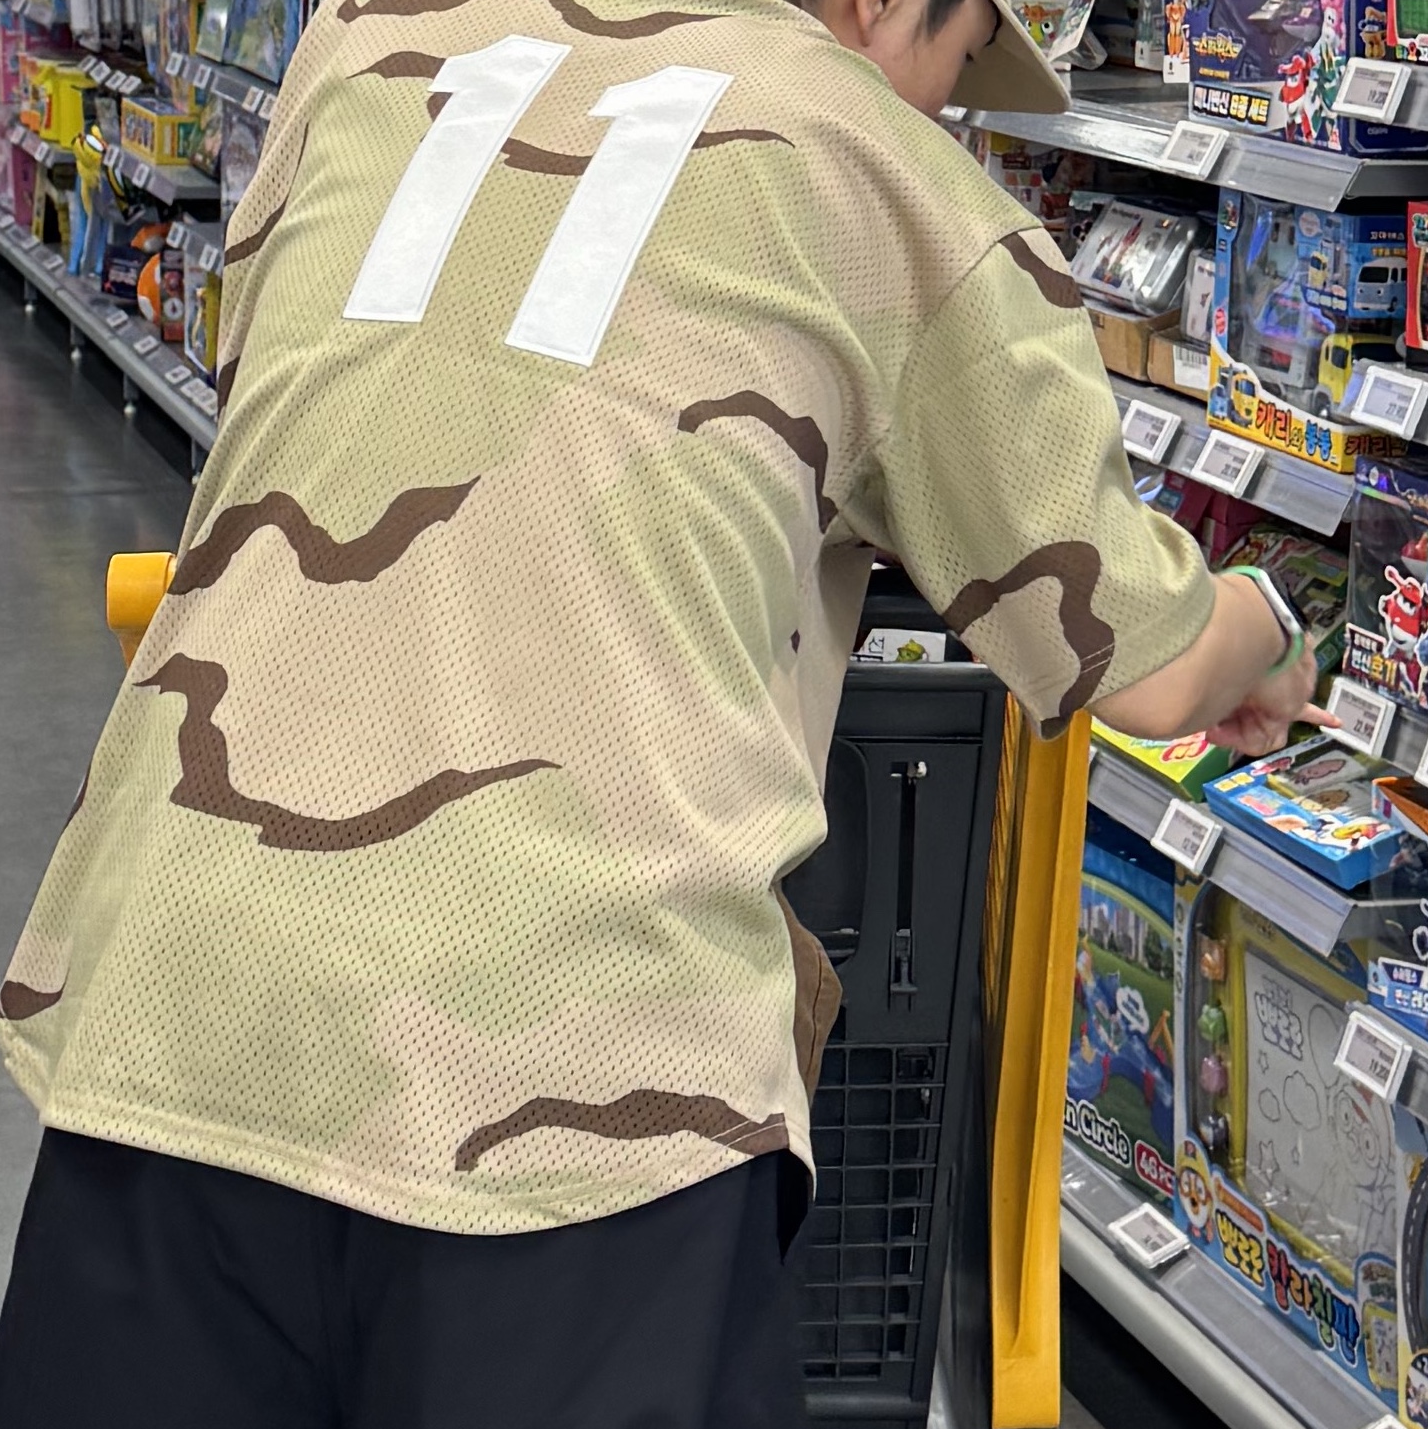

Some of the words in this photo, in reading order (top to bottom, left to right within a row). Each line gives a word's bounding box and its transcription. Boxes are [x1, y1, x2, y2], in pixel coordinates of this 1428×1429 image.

[343, 33, 735, 368] 11
[1078, 1103, 1130, 1164] Circle
[1215, 1208, 1265, 1288] 뽀로로
